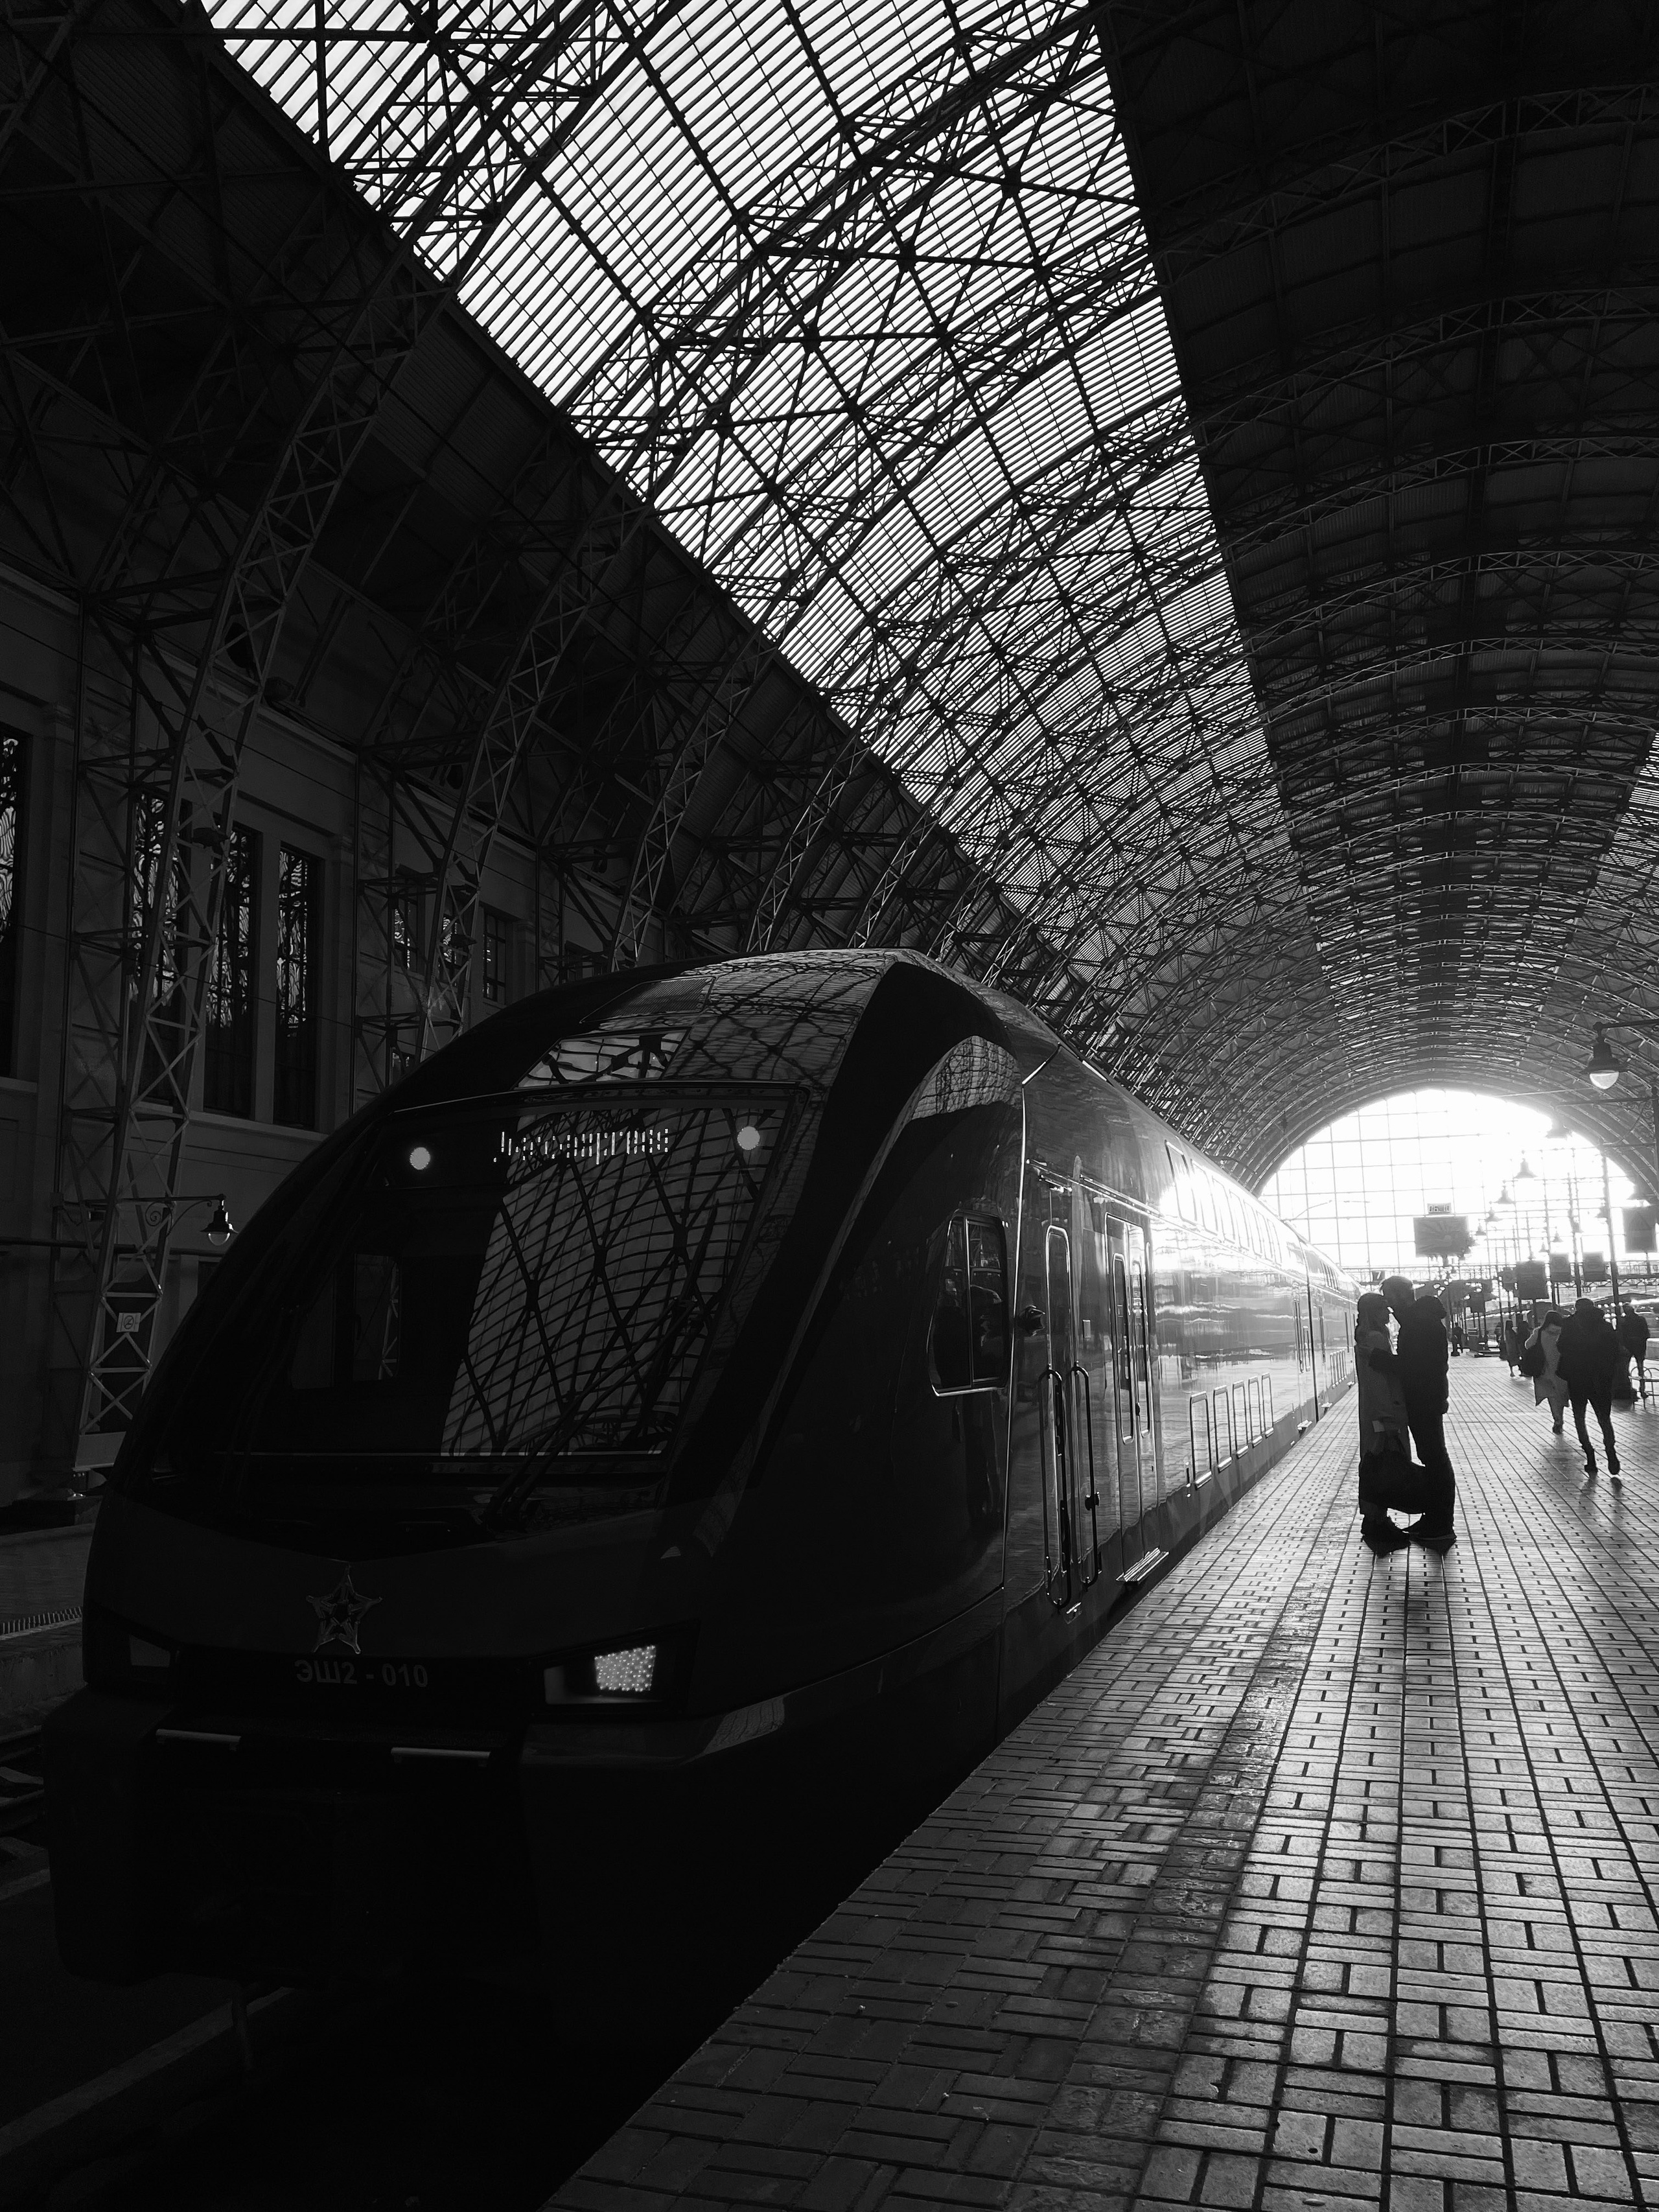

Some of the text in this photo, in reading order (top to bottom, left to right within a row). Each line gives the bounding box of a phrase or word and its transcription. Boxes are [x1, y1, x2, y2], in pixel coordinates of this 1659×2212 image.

[1375, 1271, 1382, 1279] 7
[294, 1659, 357, 1684] ЭШ2
[382, 1663, 428, 1687] 010
